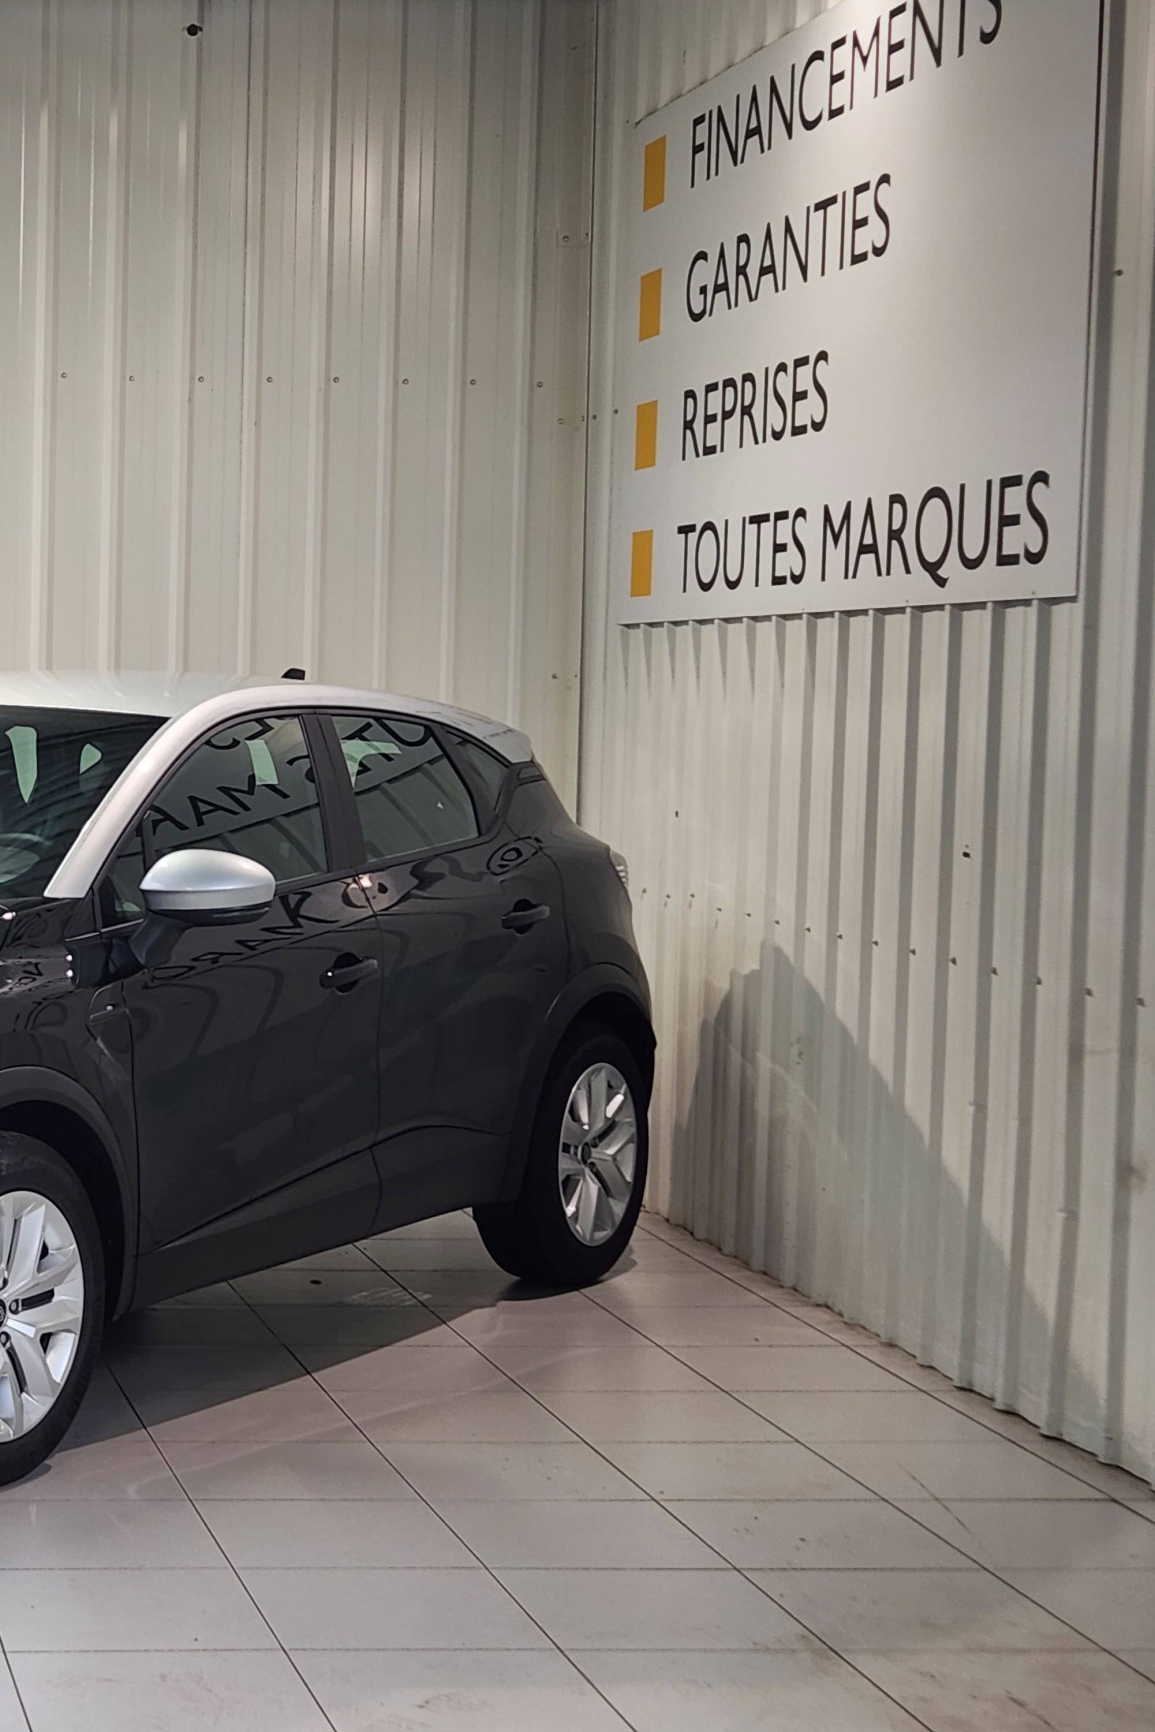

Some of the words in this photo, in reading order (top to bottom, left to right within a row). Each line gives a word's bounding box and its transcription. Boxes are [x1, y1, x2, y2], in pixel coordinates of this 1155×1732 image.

[686, 173, 892, 323] GARANTIES
[682, 350, 829, 461] REPRISES
[677, 507, 807, 593] TOUTES
[821, 470, 1051, 588] MARQUES
